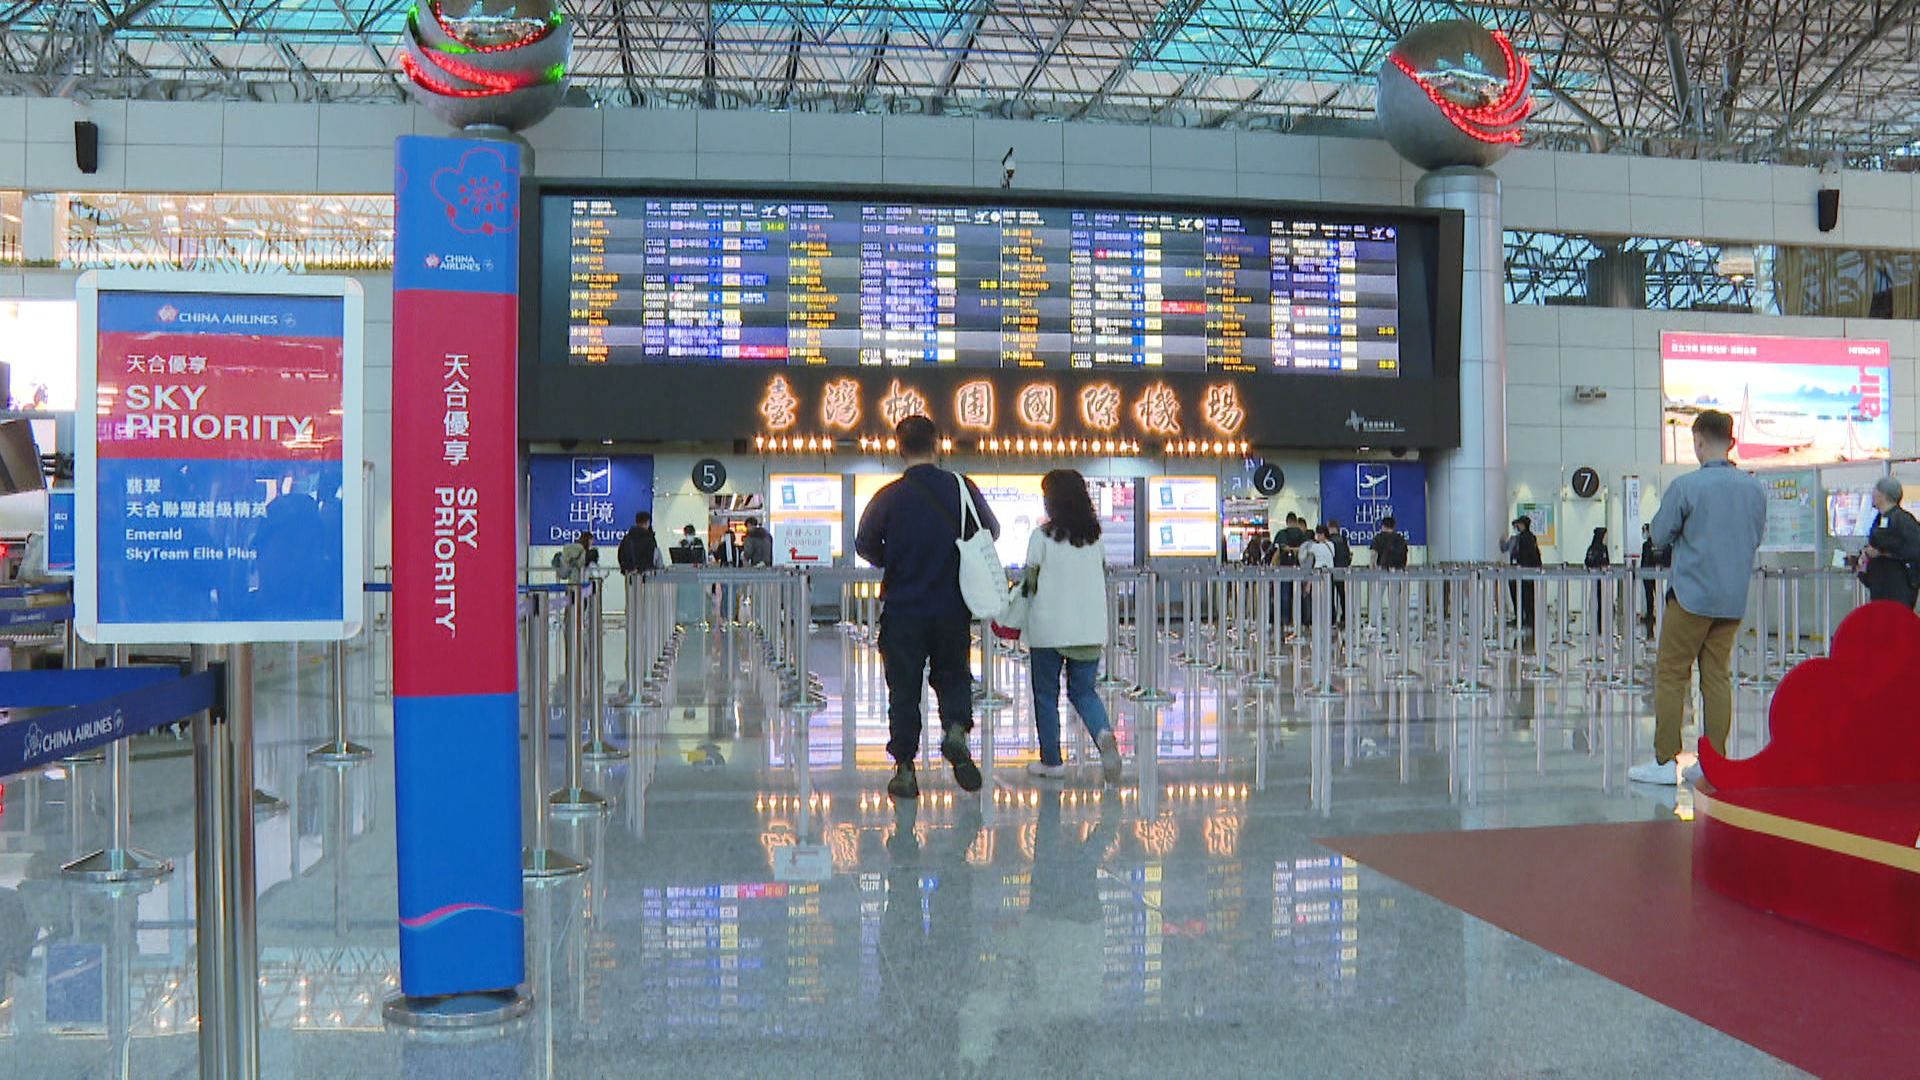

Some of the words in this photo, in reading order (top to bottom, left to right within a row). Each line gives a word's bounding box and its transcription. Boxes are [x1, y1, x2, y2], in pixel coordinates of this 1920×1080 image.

[439, 262, 481, 272] AIRLINES
[445, 255, 475, 263] CHINA
[179, 312, 220, 324] CHINA
[222, 313, 278, 325] AIRLINES
[126, 354, 208, 375] 天合優享
[126, 384, 208, 410] SKY
[1851, 367, 1881, 418] air
[443, 353, 470, 466] 天合優享
[126, 414, 313, 441] PRIORITY
[860, 437, 952, 451] TAON
[126, 477, 161, 494] 翡翠
[703, 465, 716, 487] 5
[1263, 469, 1276, 490] 6
[1581, 473, 1592, 493] 7
[126, 500, 268, 519] 天合聯盟超級精英
[457, 487, 478, 549] SKY
[570, 500, 614, 523] 出境
[126, 528, 182, 541] Emerald
[126, 547, 189, 562] SkyTeam
[194, 547, 223, 559] Elite
[228, 547, 257, 560] Plus
[434, 487, 456, 634] PRIORITY
[42, 728, 74, 752] CHINA
[74, 715, 113, 742] AIRLINES
